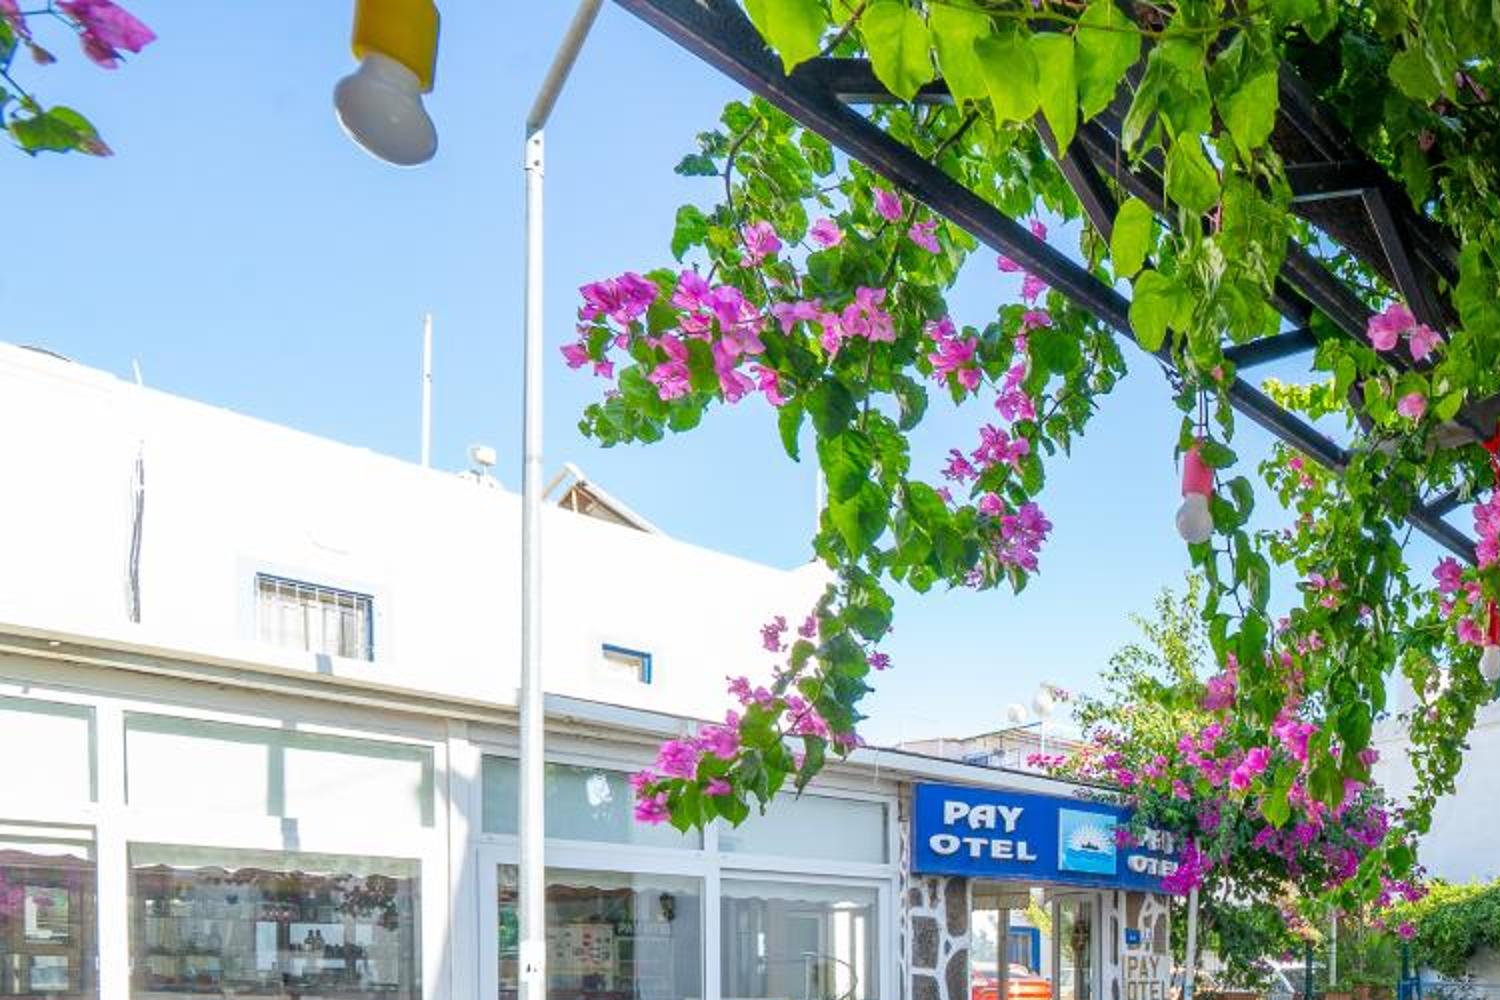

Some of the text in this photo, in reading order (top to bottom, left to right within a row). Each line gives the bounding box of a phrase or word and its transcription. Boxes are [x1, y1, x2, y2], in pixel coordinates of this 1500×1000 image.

[943, 800, 1024, 833] PAY
[929, 833, 1038, 861] OTEL
[1127, 955, 1160, 979] PAY
